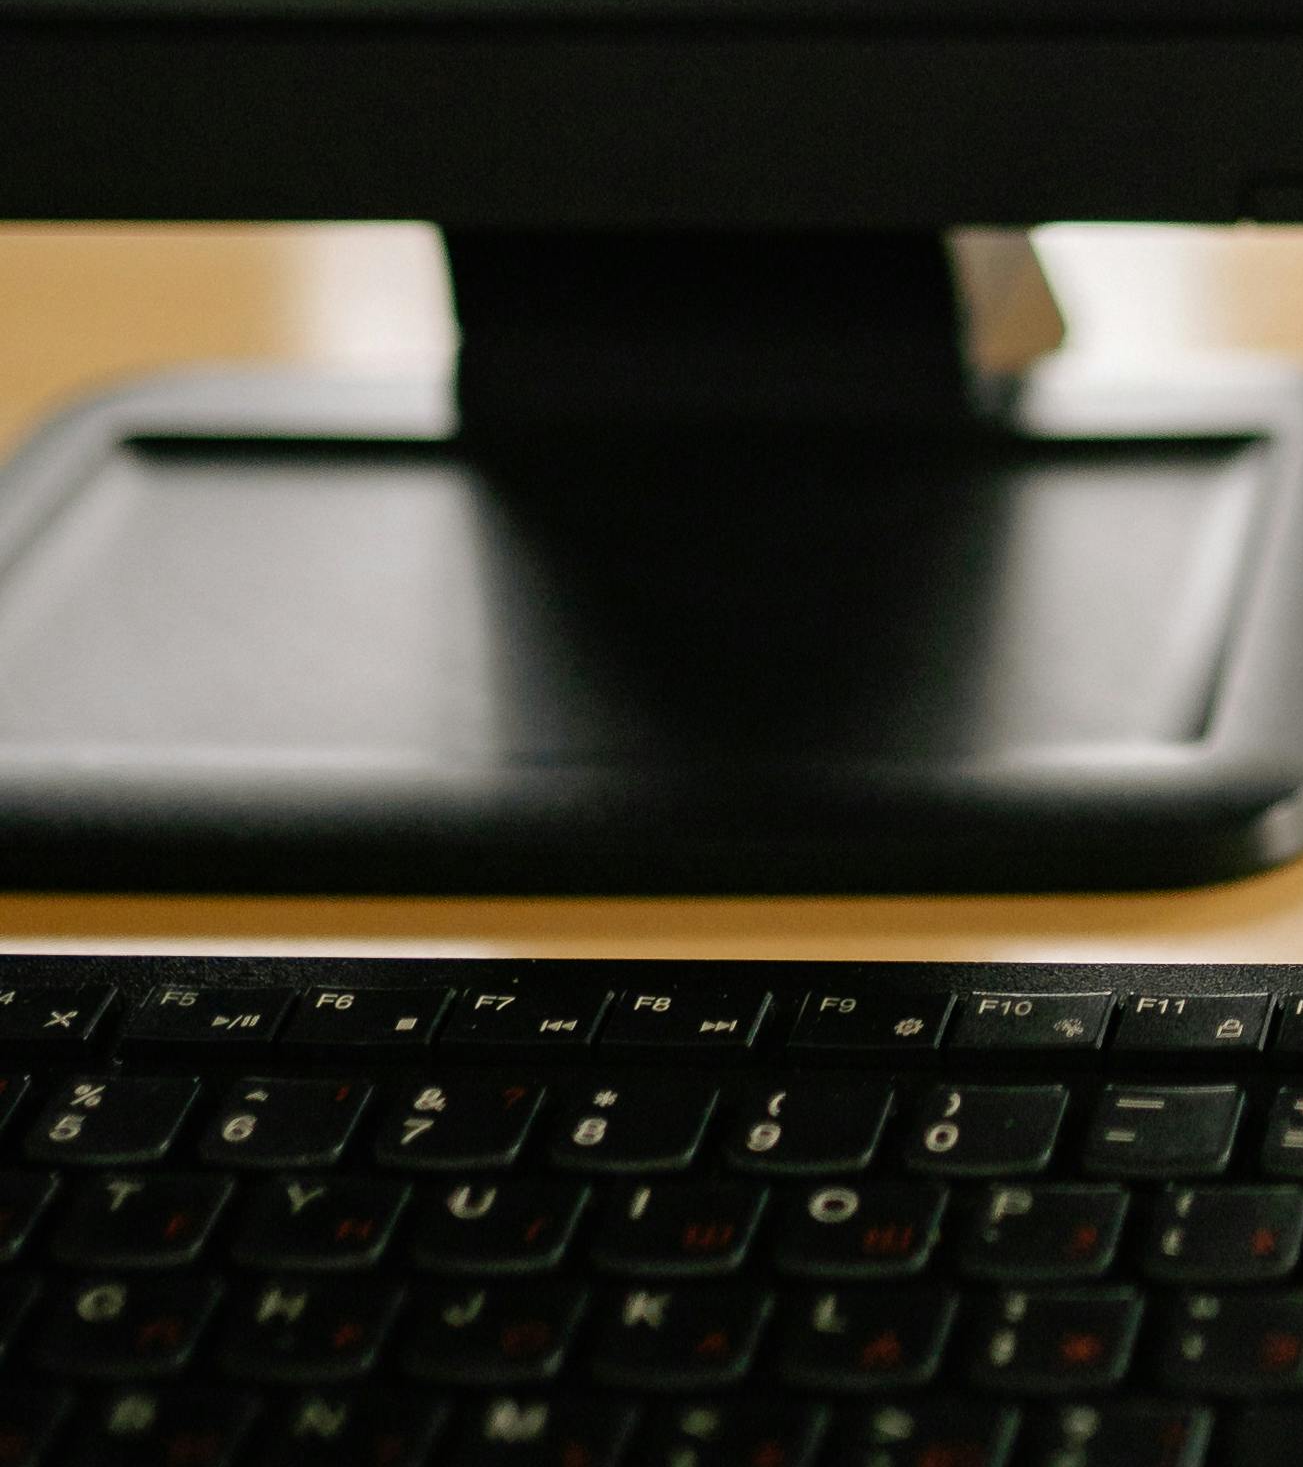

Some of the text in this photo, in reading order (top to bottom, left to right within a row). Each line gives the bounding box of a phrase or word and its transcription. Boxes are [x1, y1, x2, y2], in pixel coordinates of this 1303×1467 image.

[159, 990, 199, 1008] F5
[315, 993, 355, 1010] F6
[474, 994, 516, 1011] F7
[633, 995, 672, 1012] F8
[819, 996, 857, 1013] F9
[978, 998, 1033, 1016] F10
[1136, 997, 1187, 1015] F11
[70, 1083, 106, 1108] %
[413, 1088, 446, 1111] &
[49, 1114, 85, 1141] 5
[222, 1114, 257, 1142] 6
[401, 1118, 434, 1144] 7
[573, 1117, 608, 1145] 8
[747, 1123, 782, 1152] 9
[107, 1181, 142, 1212] T
[287, 1182, 326, 1215] Y
[447, 1186, 496, 1218] U
[631, 1188, 651, 1219] I
[990, 1188, 1033, 1221] P
[442, 1290, 487, 1328] J
[623, 1291, 671, 1328] K
